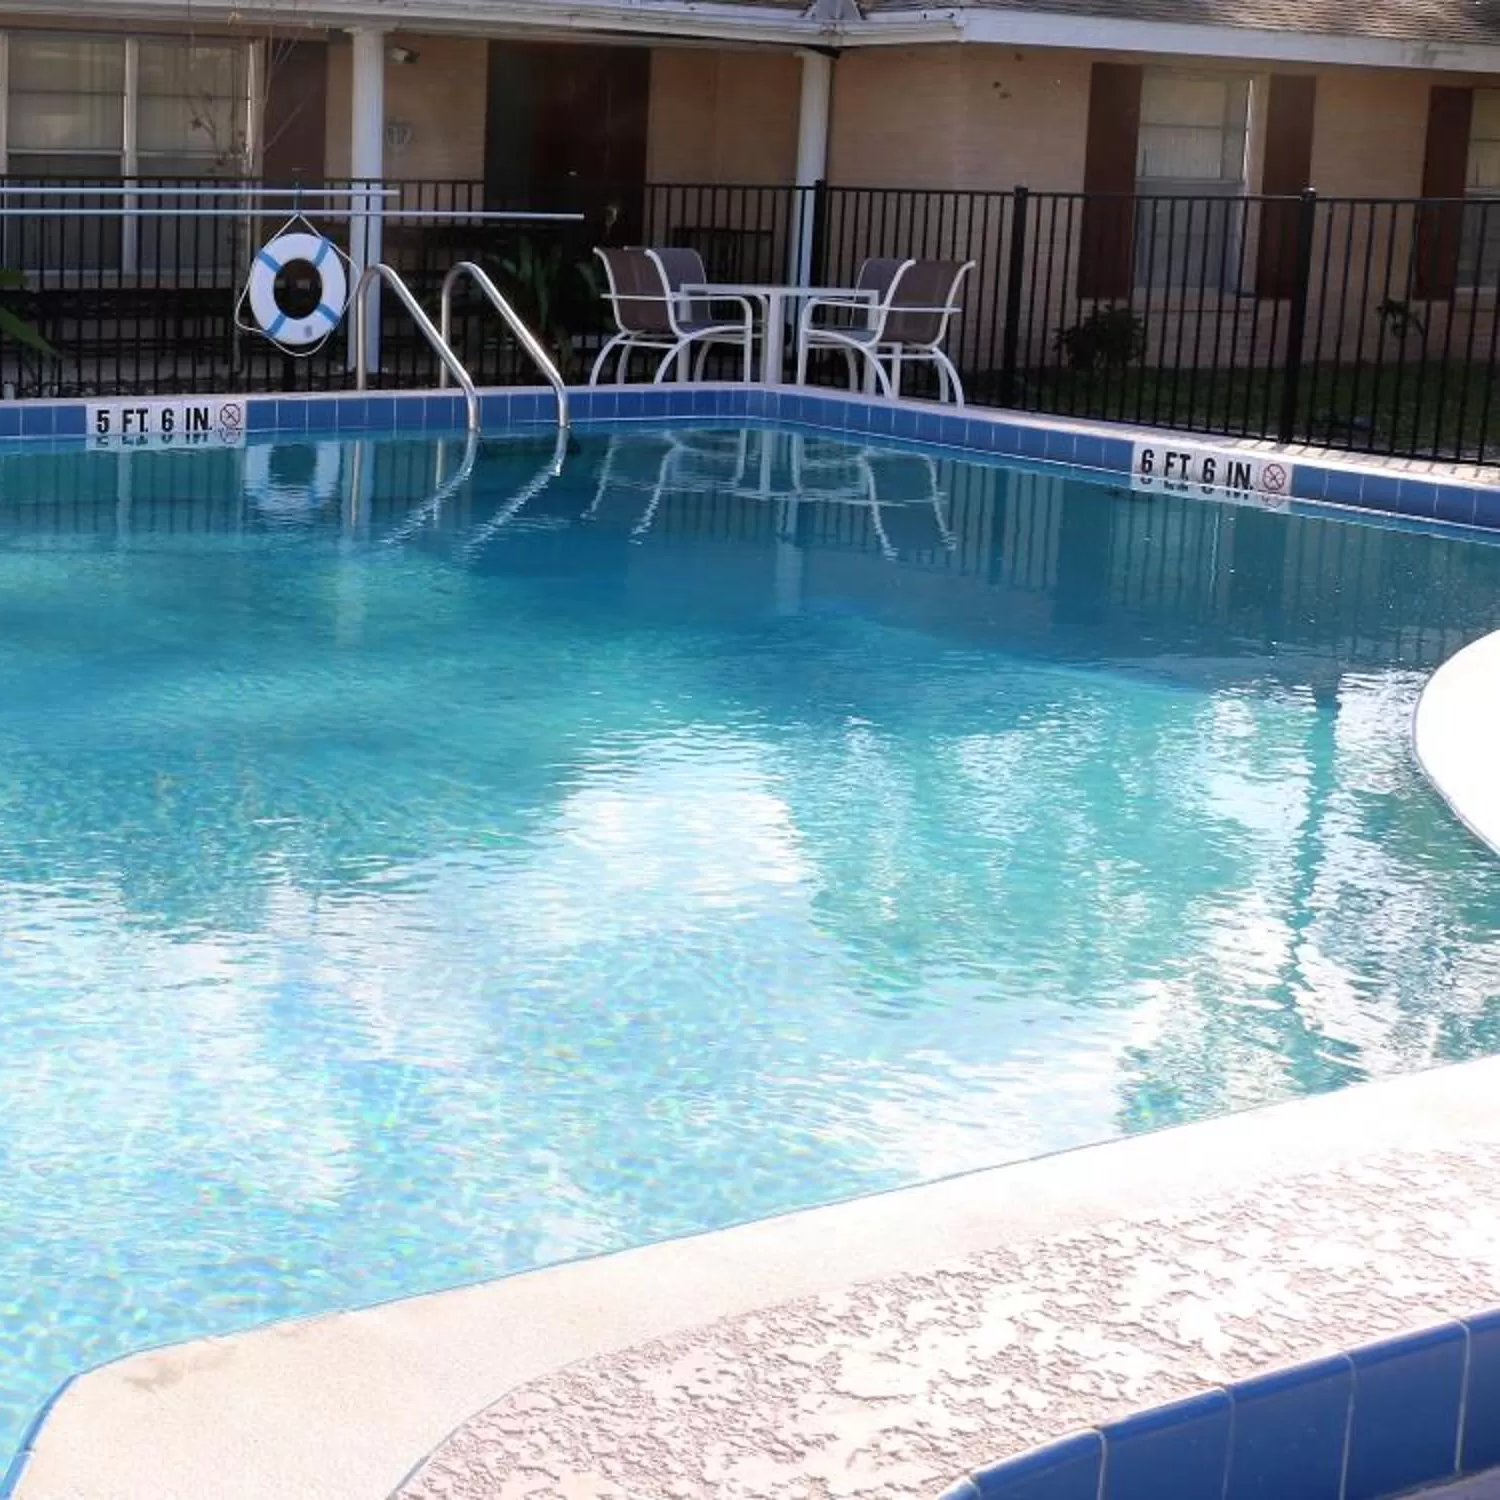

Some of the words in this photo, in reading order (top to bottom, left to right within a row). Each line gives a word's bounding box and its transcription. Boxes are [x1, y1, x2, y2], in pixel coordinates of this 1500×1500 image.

[97, 409, 110, 434] 5
[122, 408, 149, 433] FT.
[161, 408, 174, 433] 6
[185, 407, 212, 431] IN.
[1141, 449, 1155, 475] 6
[1164, 451, 1191, 481] FT.
[1202, 458, 1216, 485] 6
[1225, 461, 1253, 491] IN.
